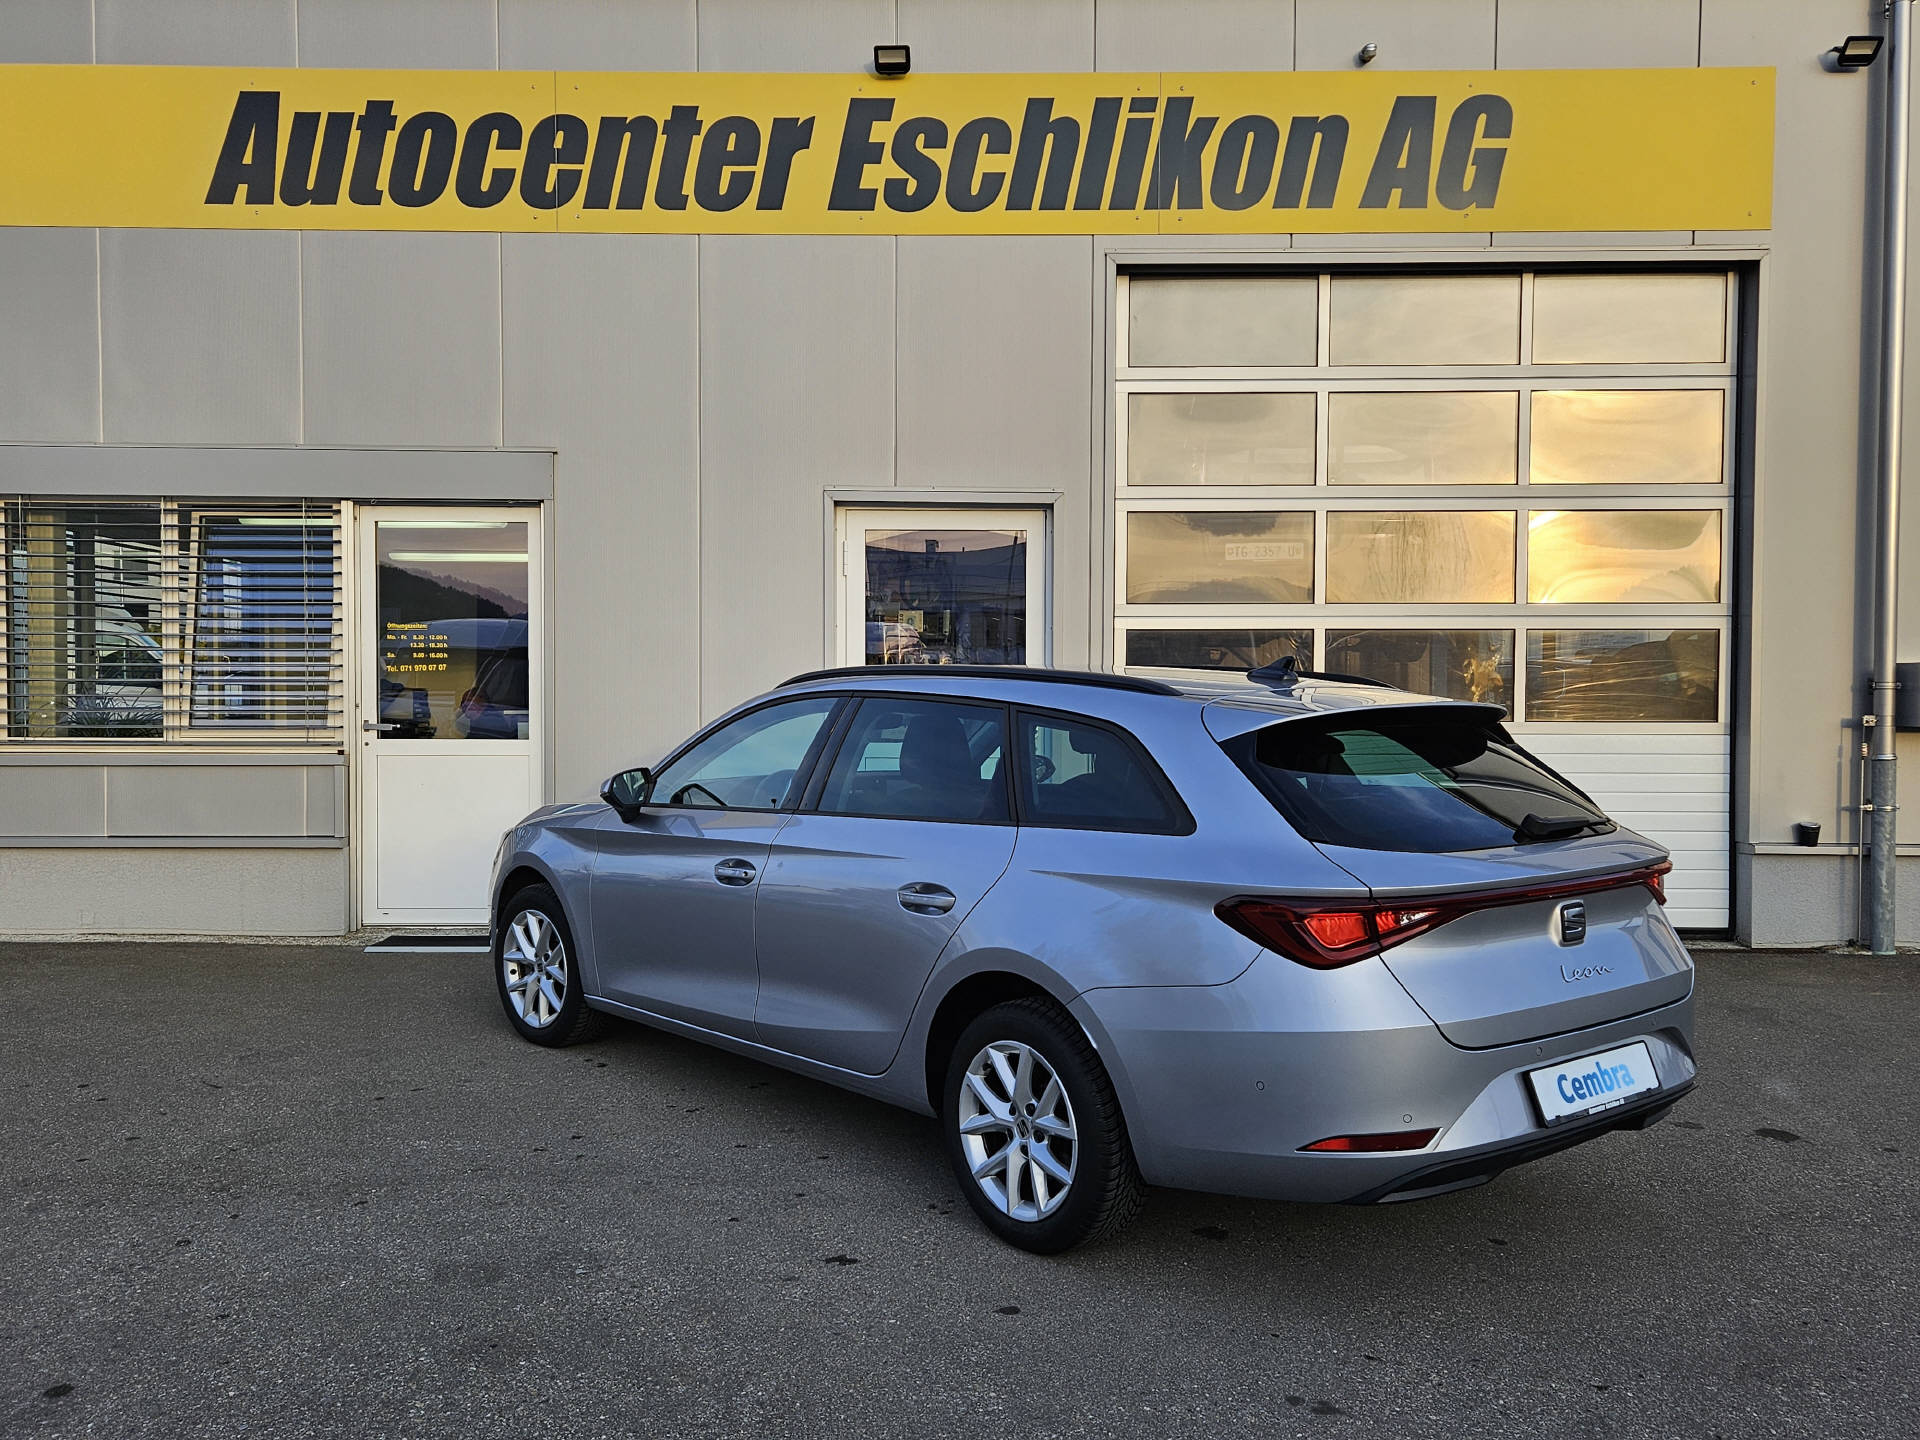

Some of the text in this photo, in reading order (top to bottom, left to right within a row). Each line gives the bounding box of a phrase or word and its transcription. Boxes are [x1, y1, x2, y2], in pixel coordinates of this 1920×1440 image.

[203, 90, 1514, 213] Autocenter Eschlikon AG
[438, 663, 447, 671] 07
[1560, 964, 1616, 984] Leon
[1556, 1060, 1635, 1104] Cembra
